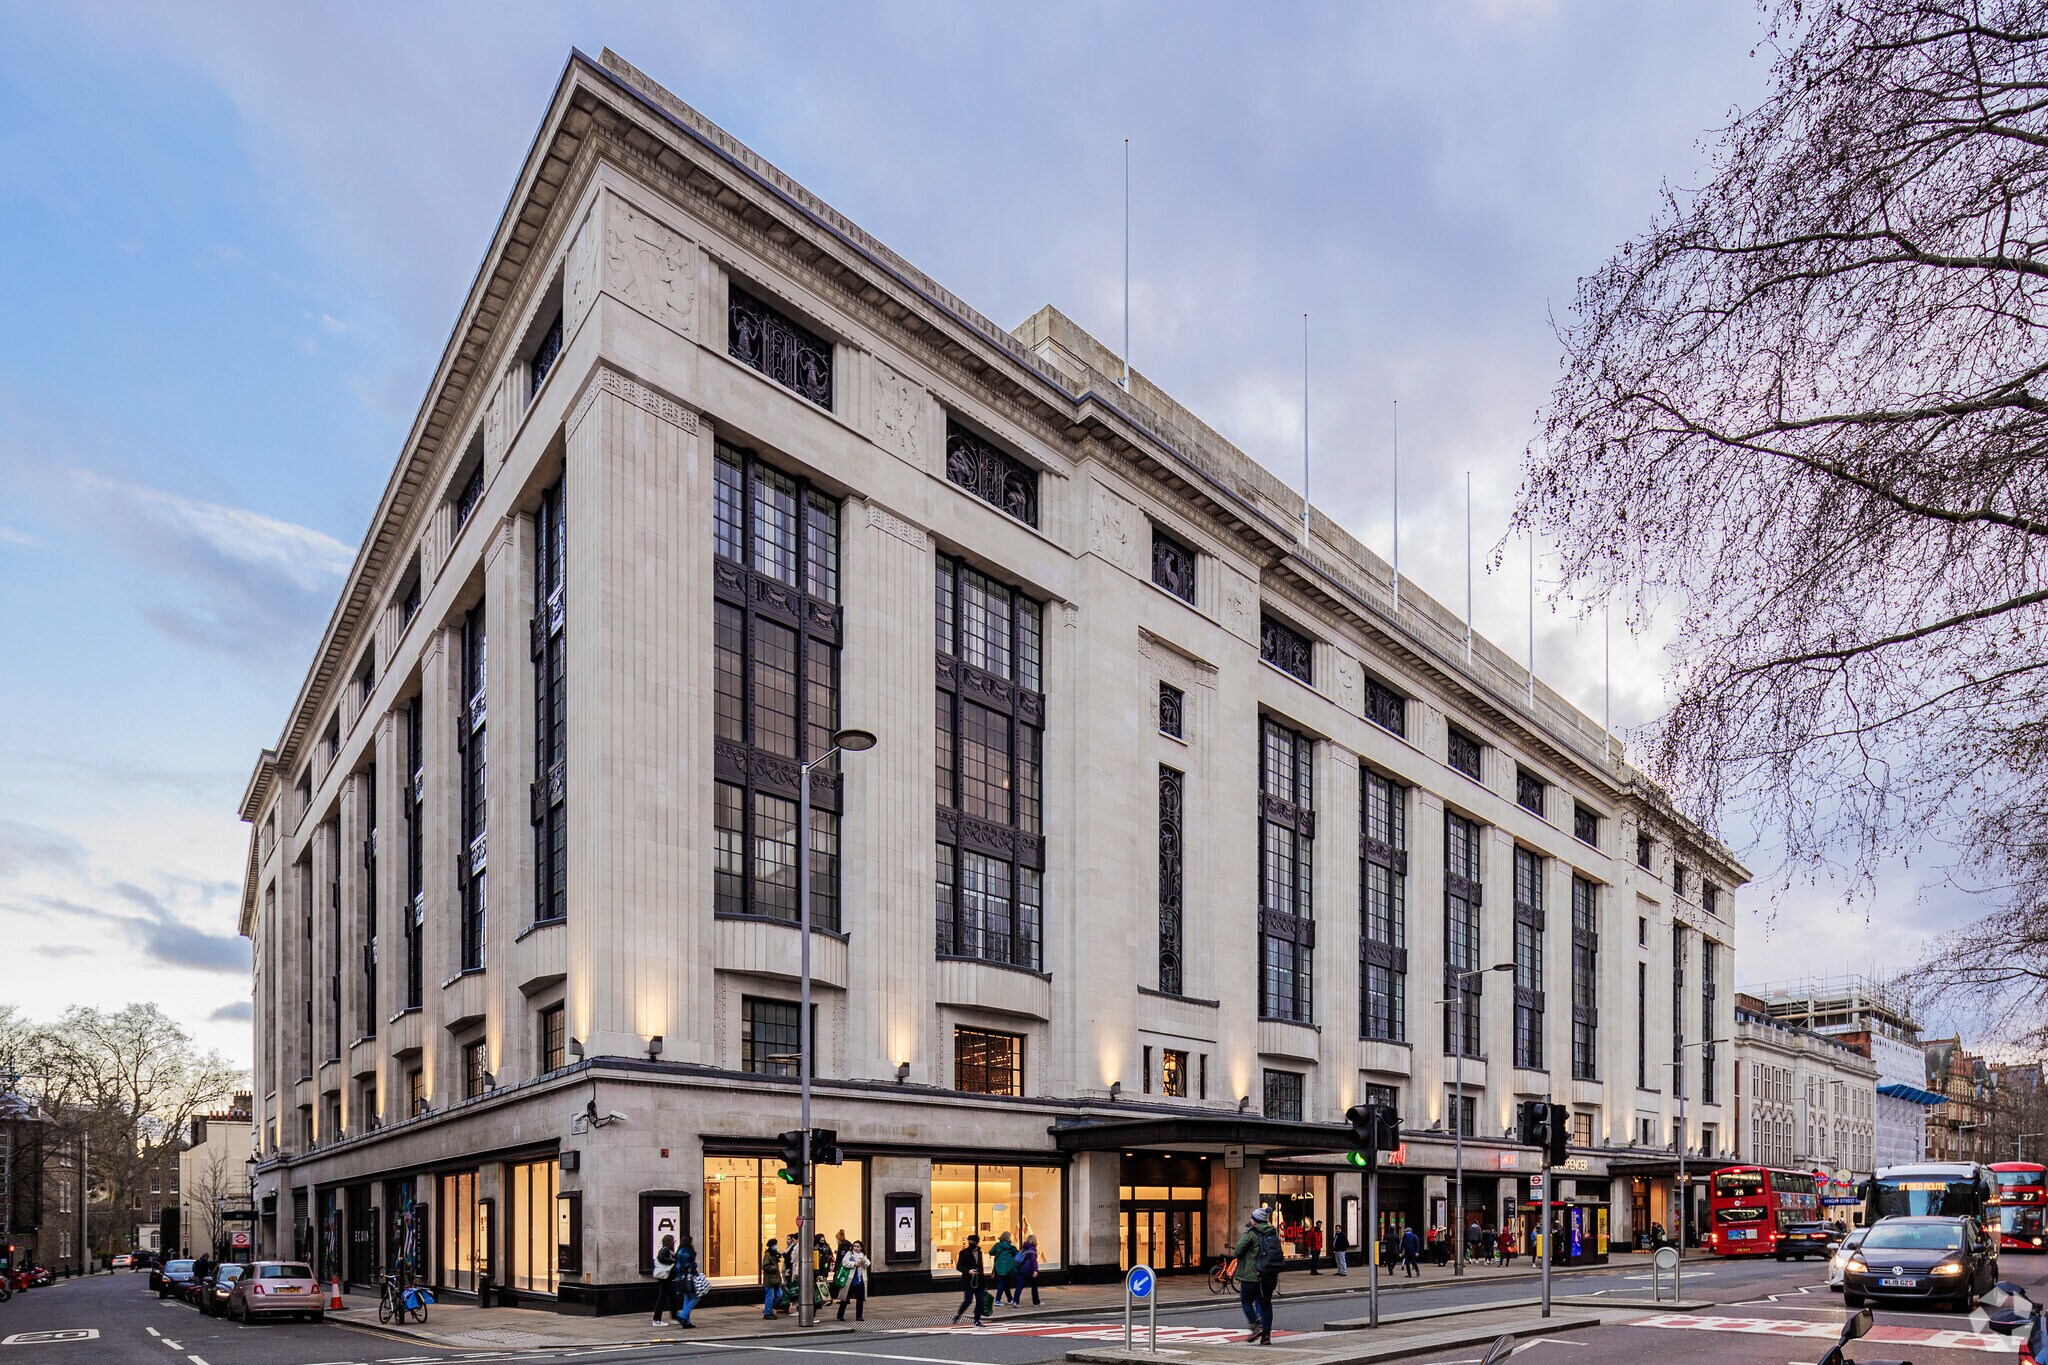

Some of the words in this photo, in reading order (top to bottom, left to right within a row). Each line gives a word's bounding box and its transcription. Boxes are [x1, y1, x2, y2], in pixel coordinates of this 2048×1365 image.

[1924, 1182, 1946, 1191] ROUTE
[2023, 1193, 2034, 1201] 27
[1280, 1221, 1303, 1239] Sale
